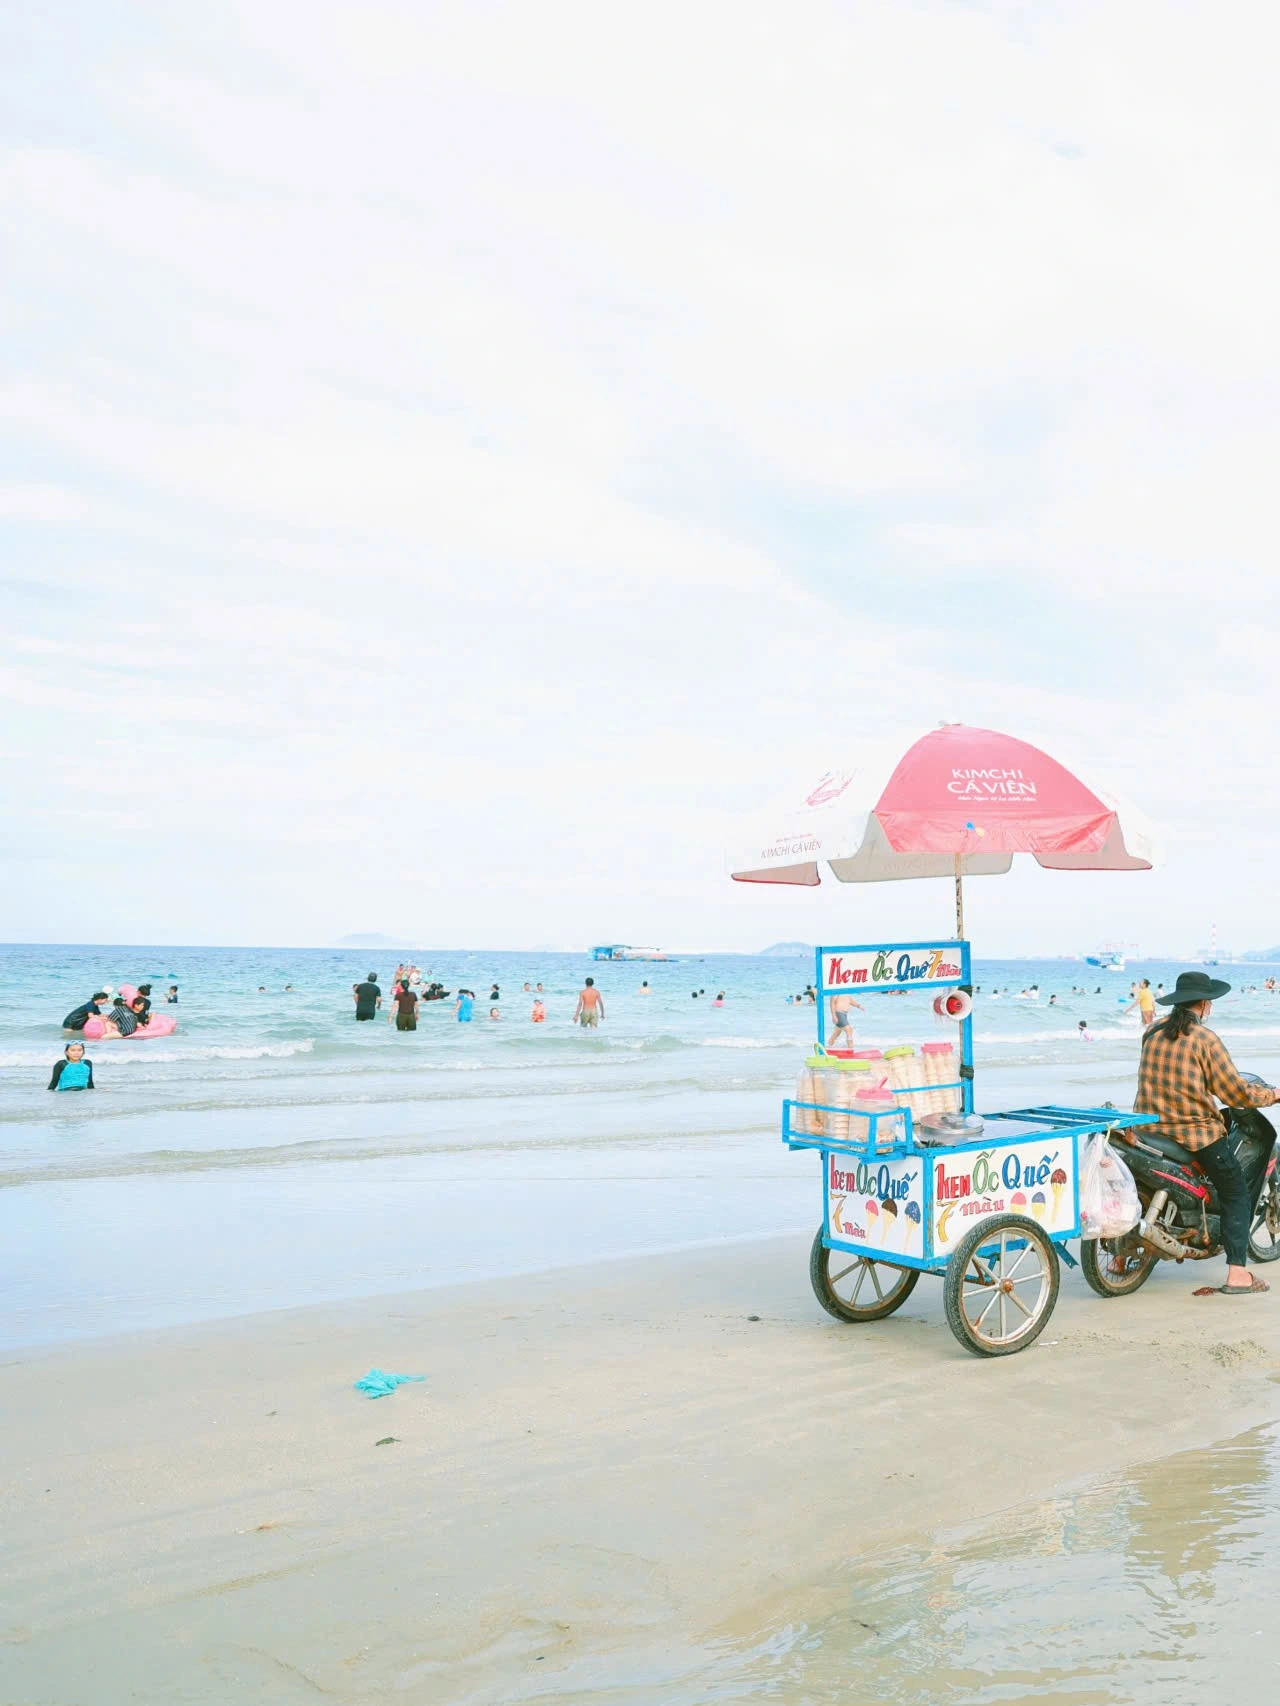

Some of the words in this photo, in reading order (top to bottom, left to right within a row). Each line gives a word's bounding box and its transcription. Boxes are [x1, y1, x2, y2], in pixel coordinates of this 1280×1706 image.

[947, 780, 982, 793] CÁ
[982, 780, 1037, 794] VIÊN
[952, 768, 1024, 779] KIMCHI
[829, 957, 868, 984] Kem
[872, 949, 894, 982] Ốc
[894, 953, 934, 982] Quế
[927, 950, 944, 979] 7
[877, 1164, 918, 1201] Quế
[972, 1149, 999, 1195] Ốc
[1001, 1151, 1060, 1190] Quế
[830, 1192, 847, 1234] 7
[936, 1200, 958, 1242] 7
[960, 1196, 1005, 1216] màu
